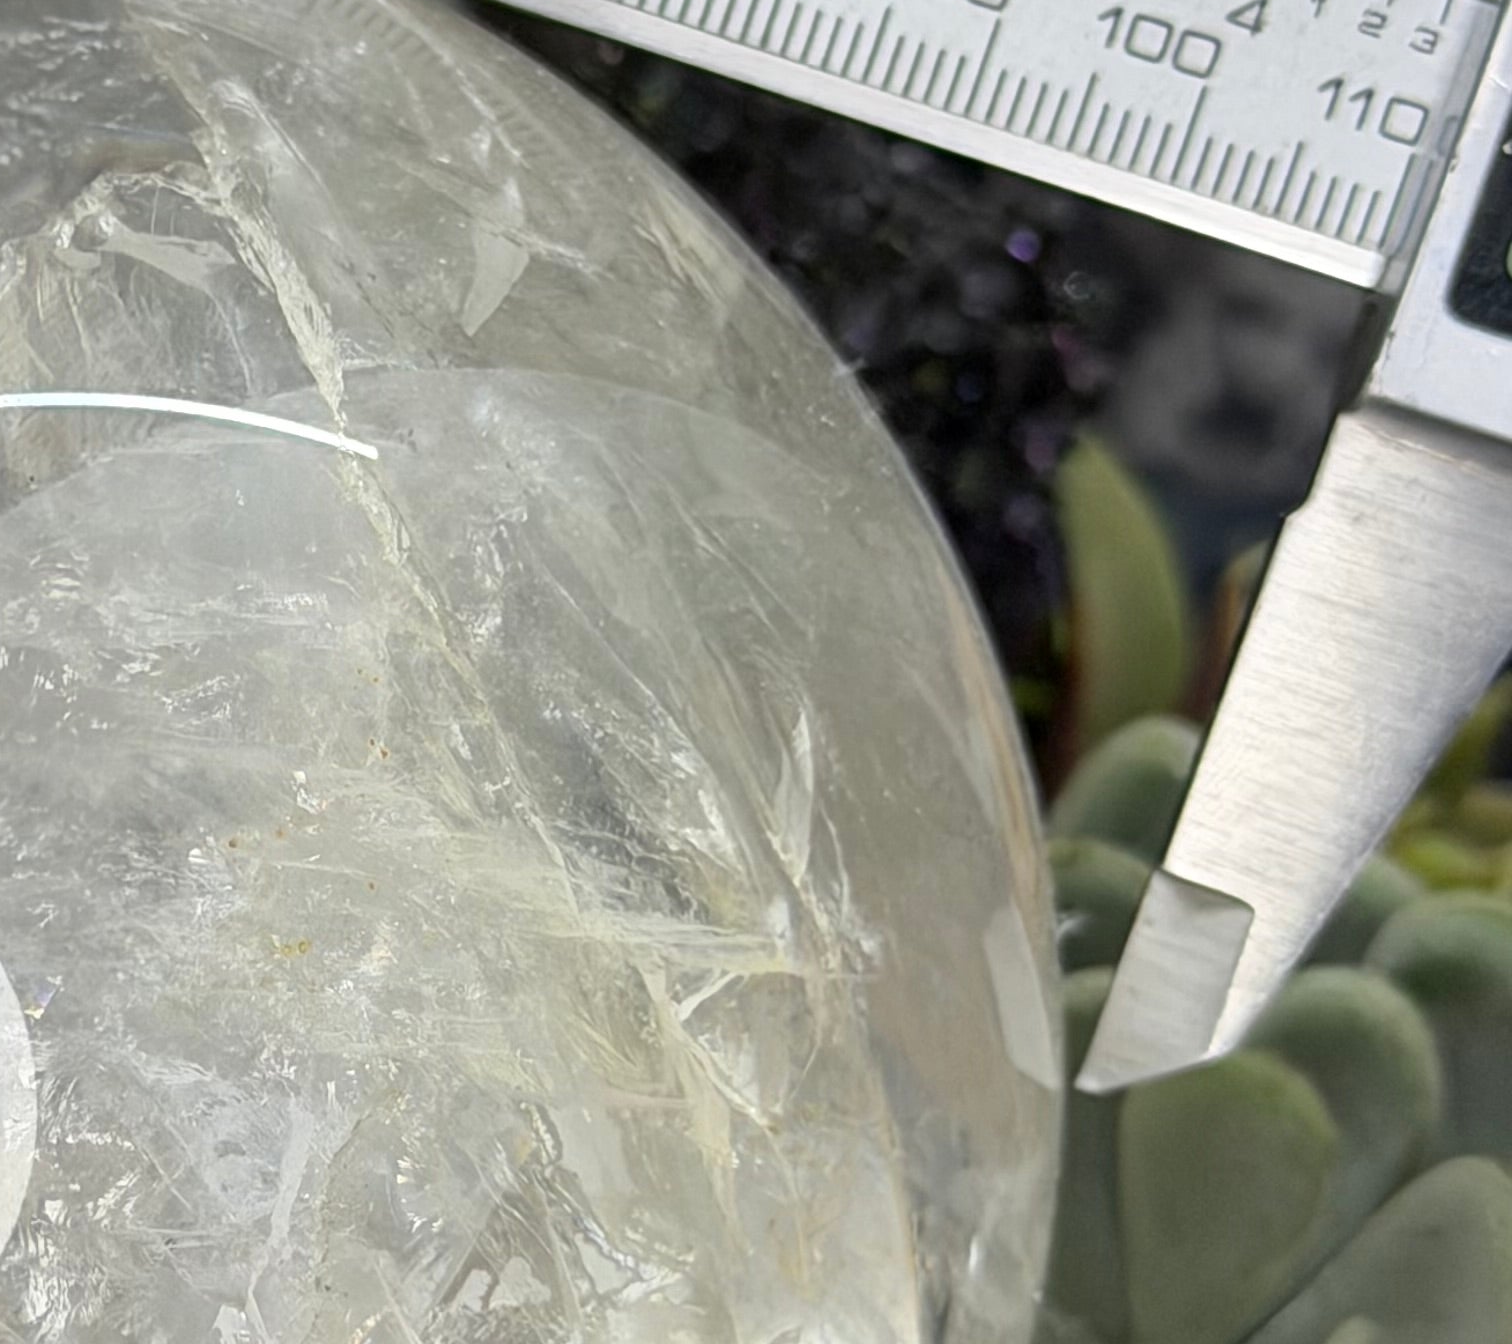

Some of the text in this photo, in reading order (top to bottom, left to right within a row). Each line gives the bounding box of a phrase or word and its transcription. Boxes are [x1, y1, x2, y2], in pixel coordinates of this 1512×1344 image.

[1098, 5, 1224, 79] 100
[1317, 76, 1430, 147] 110
[1358, 9, 1388, 38] 2
[1409, 25, 1442, 55] 3
